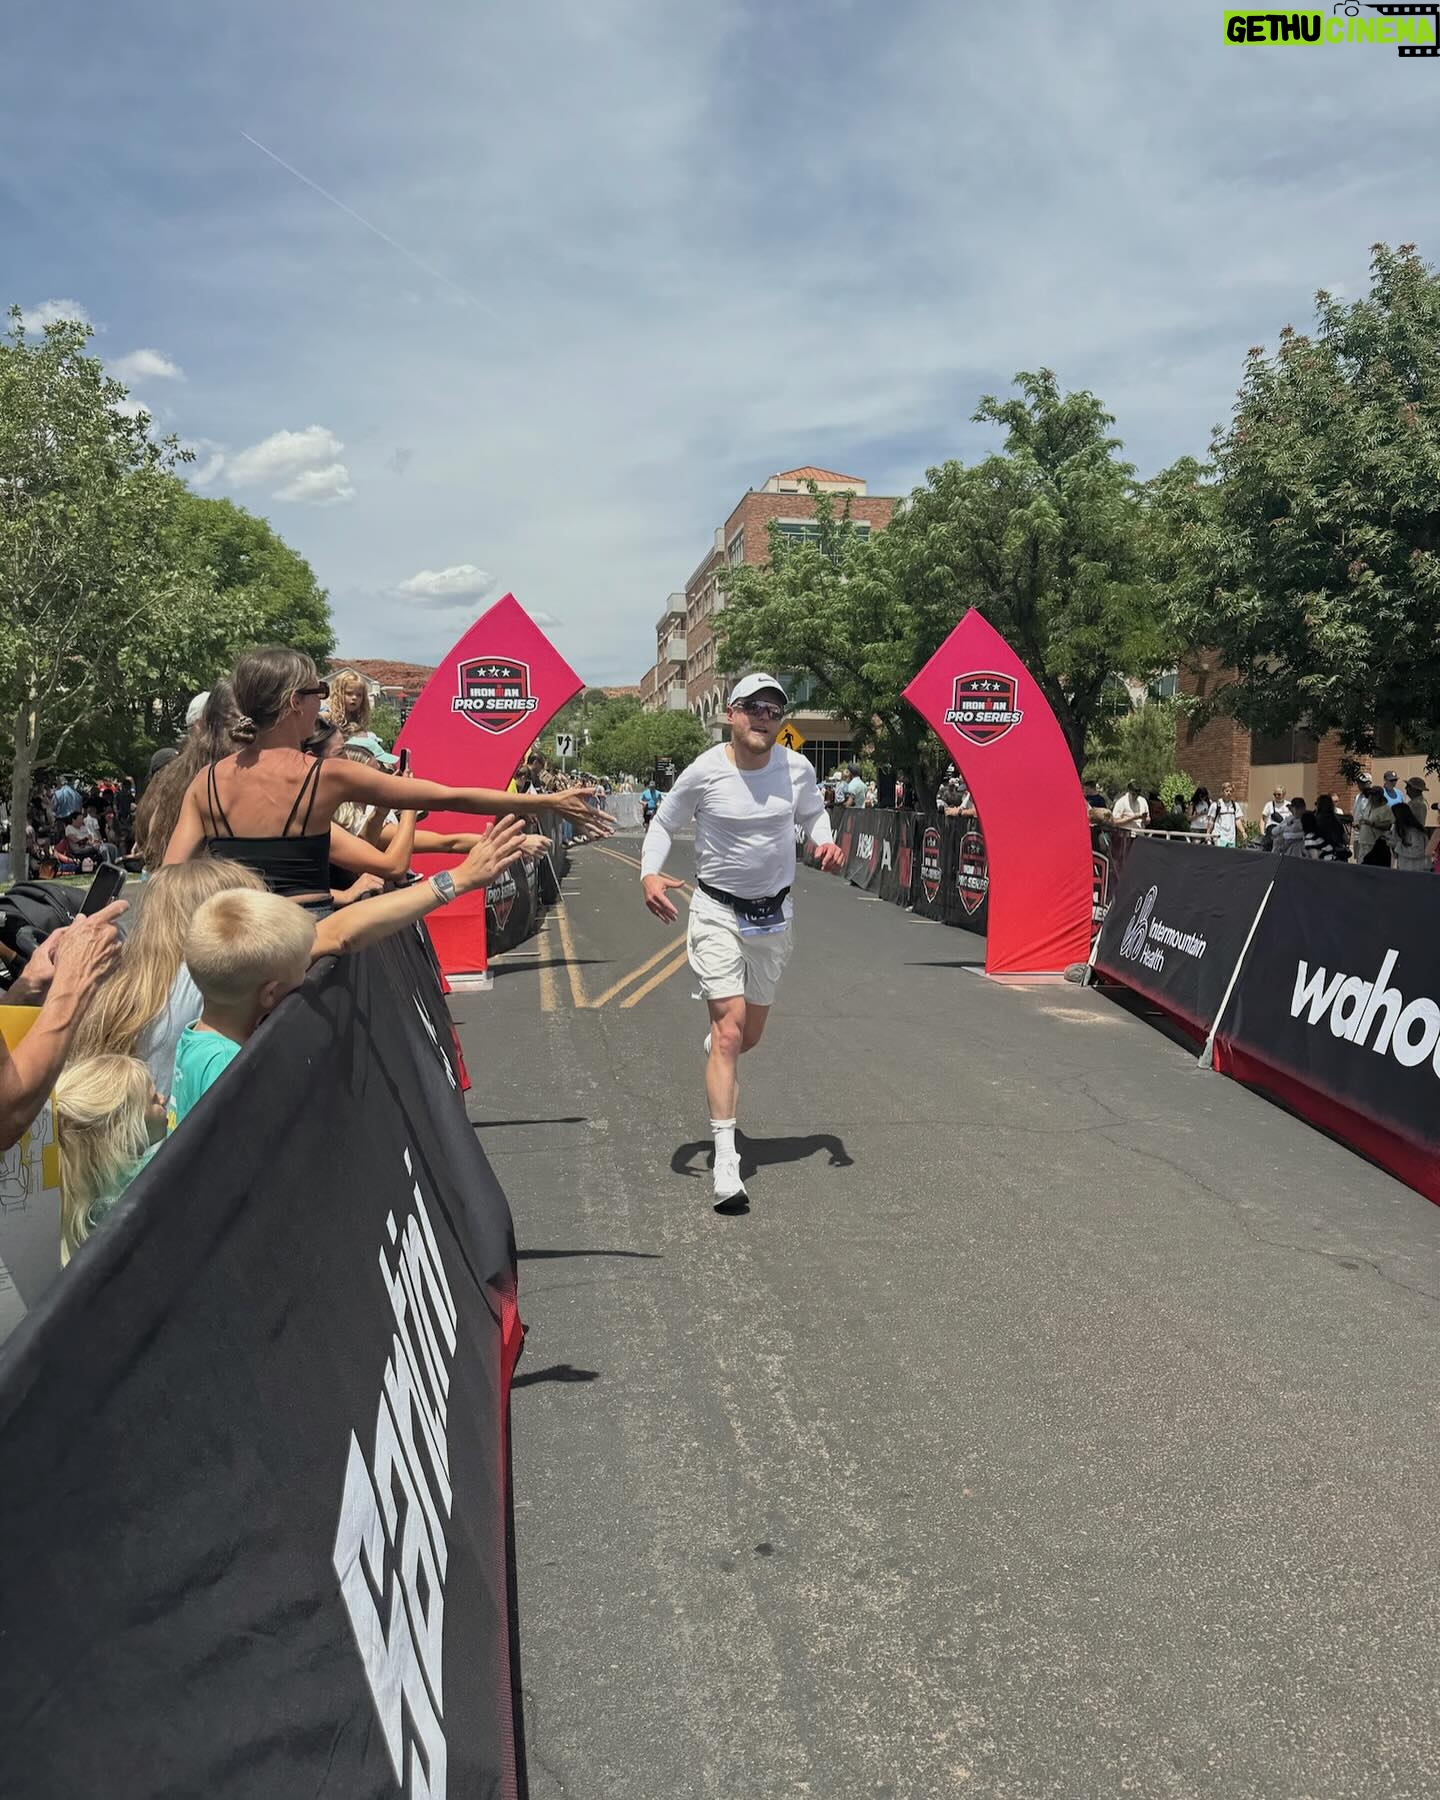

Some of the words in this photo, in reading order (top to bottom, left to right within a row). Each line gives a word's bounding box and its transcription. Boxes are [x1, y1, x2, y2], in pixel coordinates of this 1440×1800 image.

[454, 699, 484, 710] PRO
[486, 699, 536, 710] SERIES
[946, 711, 974, 722] PRO
[975, 711, 1020, 723] SERIES
[1148, 916, 1207, 959] Intermountain
[1139, 942, 1165, 973] Health
[1290, 948, 1440, 1080] waho
[333, 1147, 457, 1800] Santini
